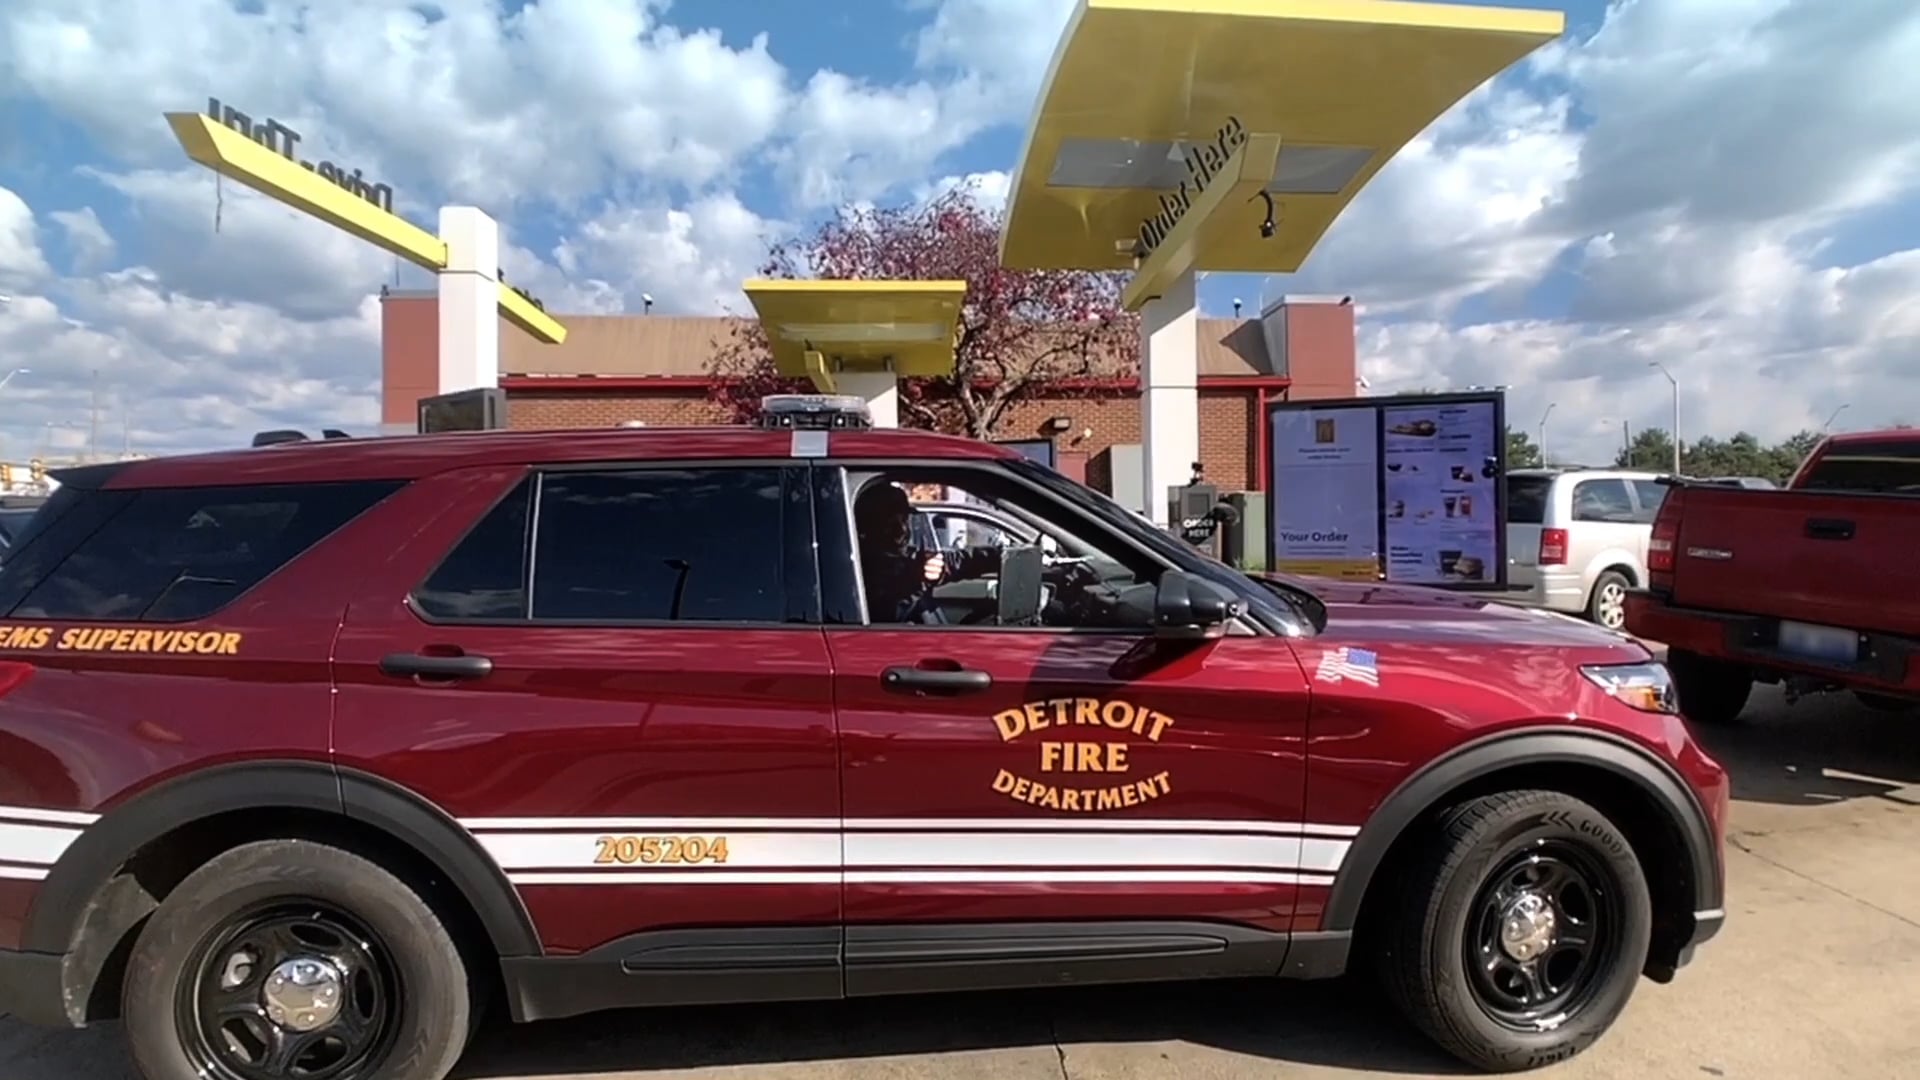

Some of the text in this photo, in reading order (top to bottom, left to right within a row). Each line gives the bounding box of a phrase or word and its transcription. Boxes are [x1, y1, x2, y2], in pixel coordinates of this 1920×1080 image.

[1139, 115, 1245, 249] Order Here
[1280, 531, 1349, 542] Your Order
[0, 626, 241, 654] EMS SUPERVISOR
[992, 697, 1175, 742] DETROIT
[1041, 741, 1129, 772] FIRE
[991, 768, 1172, 811] DEPARTMENT
[593, 836, 729, 864] 205204
